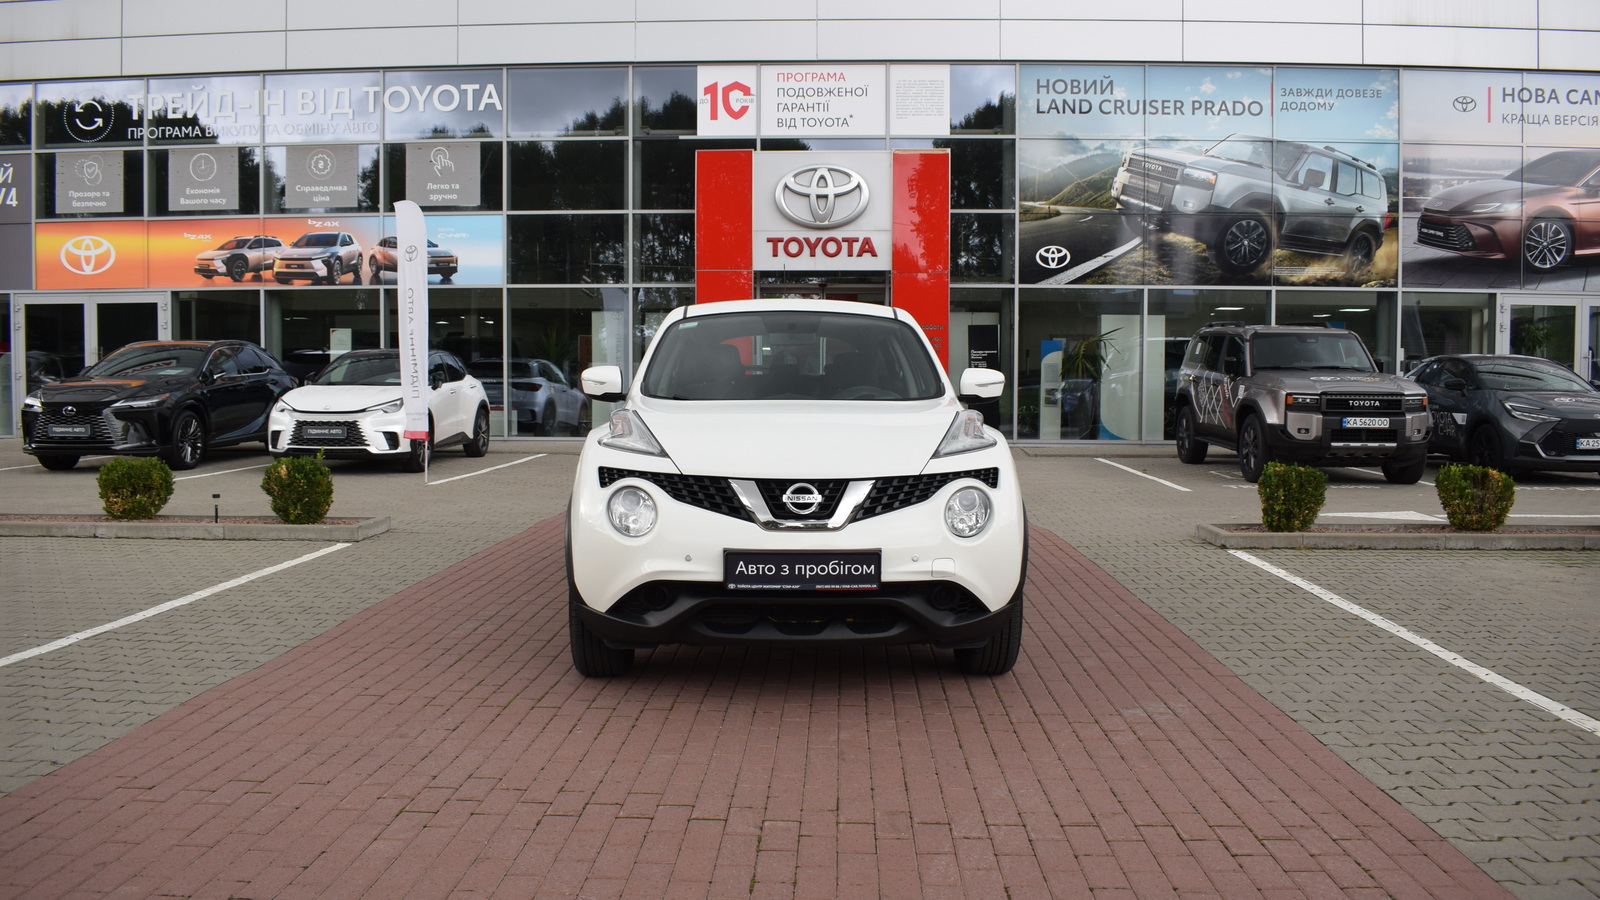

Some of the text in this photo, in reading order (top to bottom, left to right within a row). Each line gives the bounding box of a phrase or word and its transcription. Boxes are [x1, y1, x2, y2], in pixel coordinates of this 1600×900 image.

[777, 72, 846, 82] ПРОГРАМА
[1036, 75, 1114, 95] НОВИЙ
[777, 84, 869, 99] ПОДОВЖЕНОЇ
[1280, 88, 1382, 99] ЗАВЖДИ ДОВЕЗЕ
[1502, 87, 1560, 104] НОВА
[127, 83, 503, 124] ТРЕЙД-ІН ВІД TOYOTA
[777, 100, 831, 112] ГАРАНТІЇ
[1036, 99, 1263, 117] LAND CRUISER PRADO
[1280, 101, 1335, 112] ДОДОМУ
[777, 117, 797, 129] ВІД
[1502, 113, 1598, 127] КРАЩА ВЕРСІЯ
[127, 121, 379, 139] ПРОГРАМА ВИКУПУ ТА ОБМІНУ АВТО
[1141, 162, 1162, 171] TOYOTA
[186, 186, 221, 195] Економія
[295, 184, 348, 193] Справедлива
[427, 182, 450, 190] Легко
[68, 190, 101, 199] Прозоро
[313, 194, 330, 202] ціна
[72, 199, 107, 207] безпечно
[180, 197, 227, 205] Вашого часу
[766, 237, 878, 257] TOYOTA
[1359, 419, 1376, 427] 5620
[735, 560, 875, 579] Авто з пробігом
